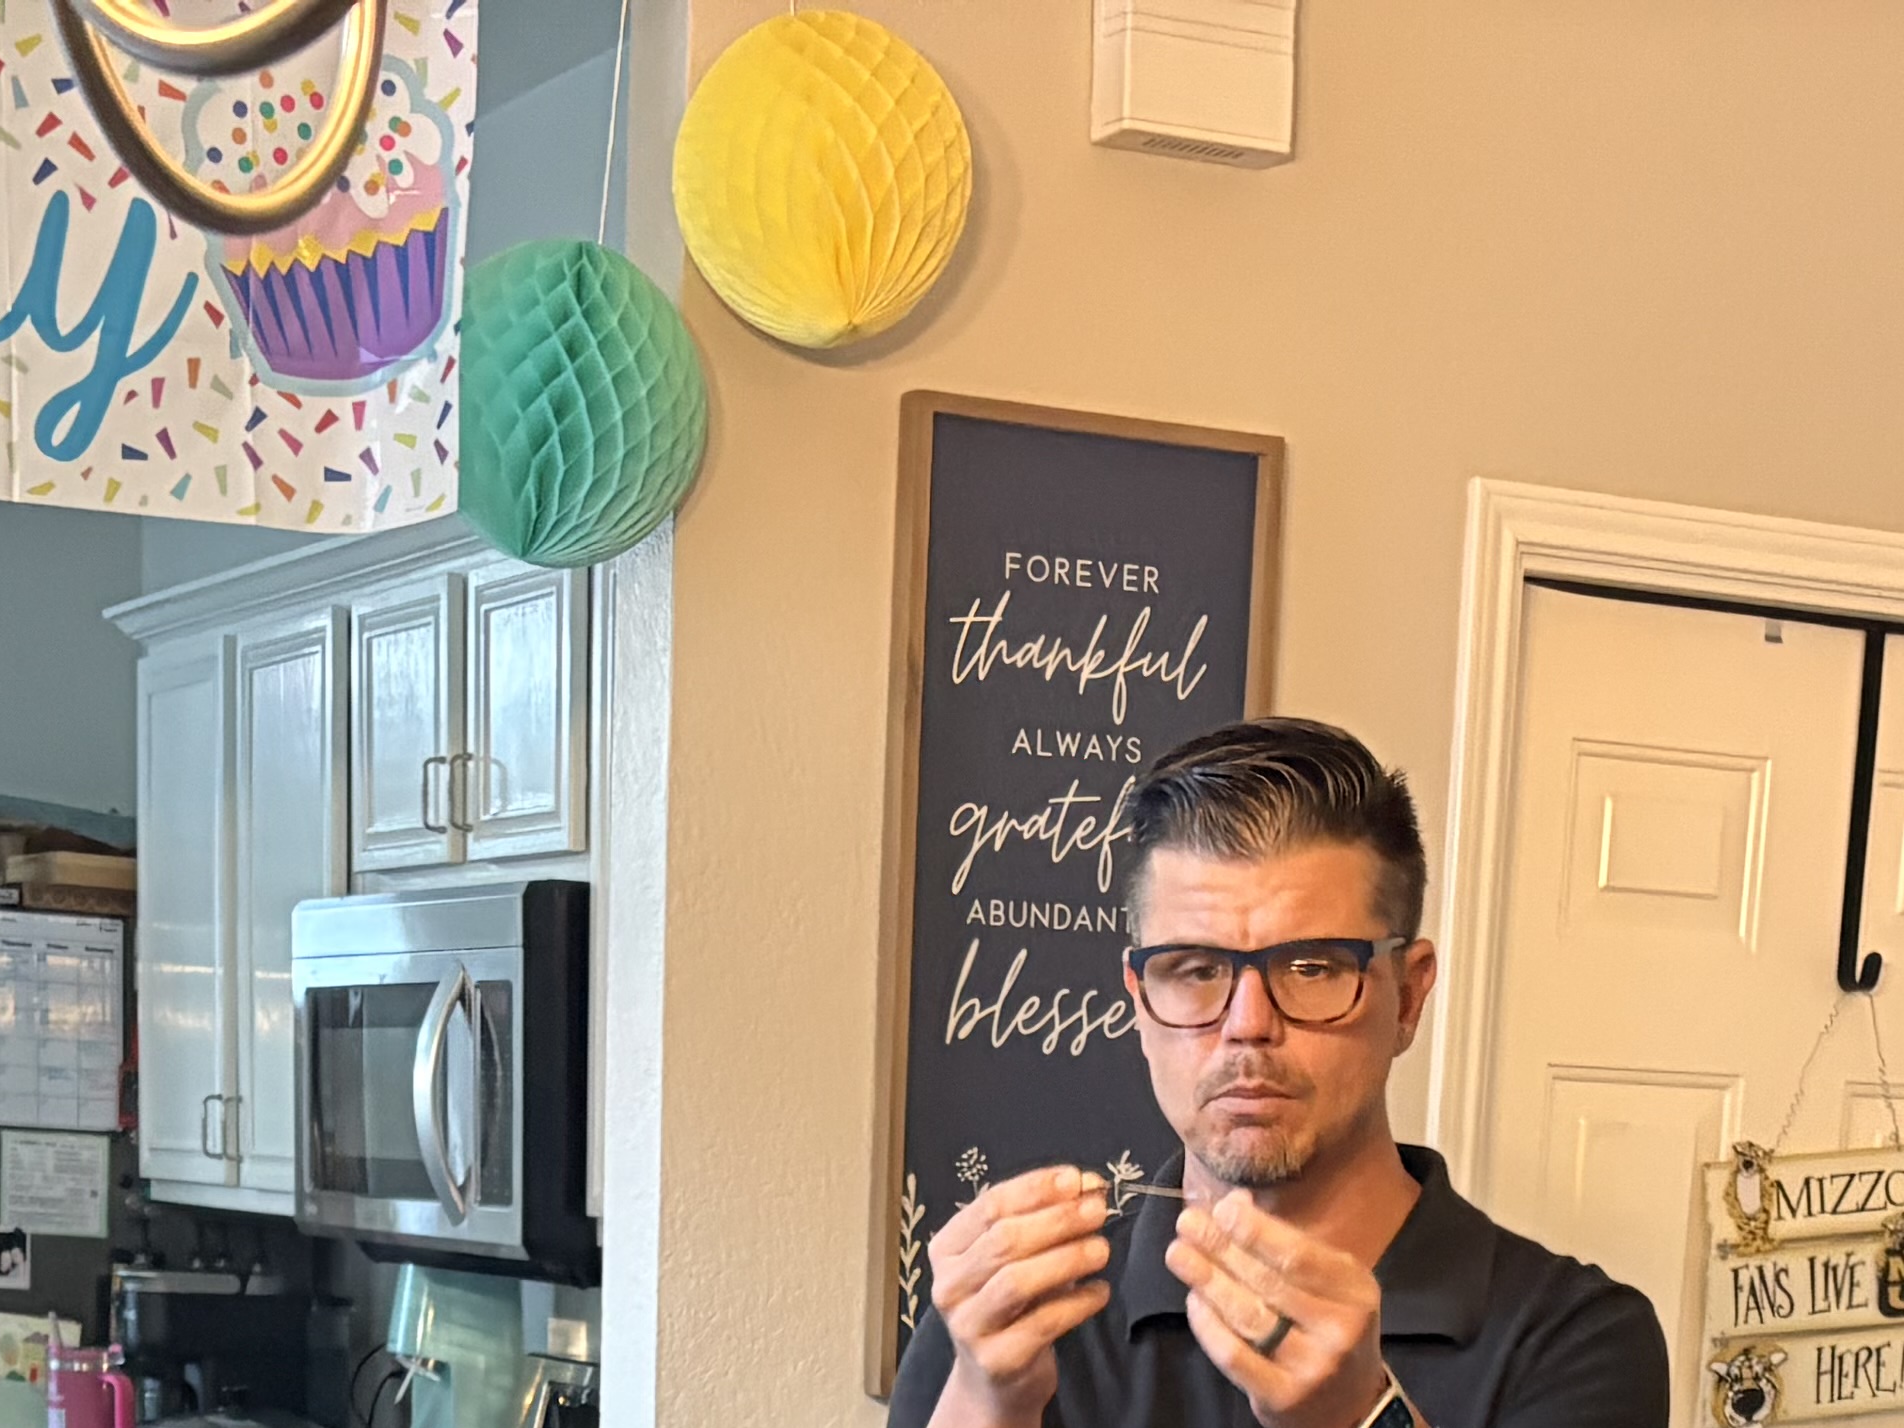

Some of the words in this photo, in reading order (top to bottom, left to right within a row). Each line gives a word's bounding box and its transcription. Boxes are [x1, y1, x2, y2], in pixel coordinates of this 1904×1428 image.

[1004, 552, 1160, 594] FOREVER
[949, 592, 1207, 723] thankful
[1010, 729, 1143, 763] ALWAYS
[949, 776, 1136, 894] gratef
[966, 900, 1134, 934] ABUNDANT
[945, 938, 1138, 1056] blesse
[1731, 1262, 1795, 1328] FANS
[1808, 1251, 1868, 1316] LIVE
